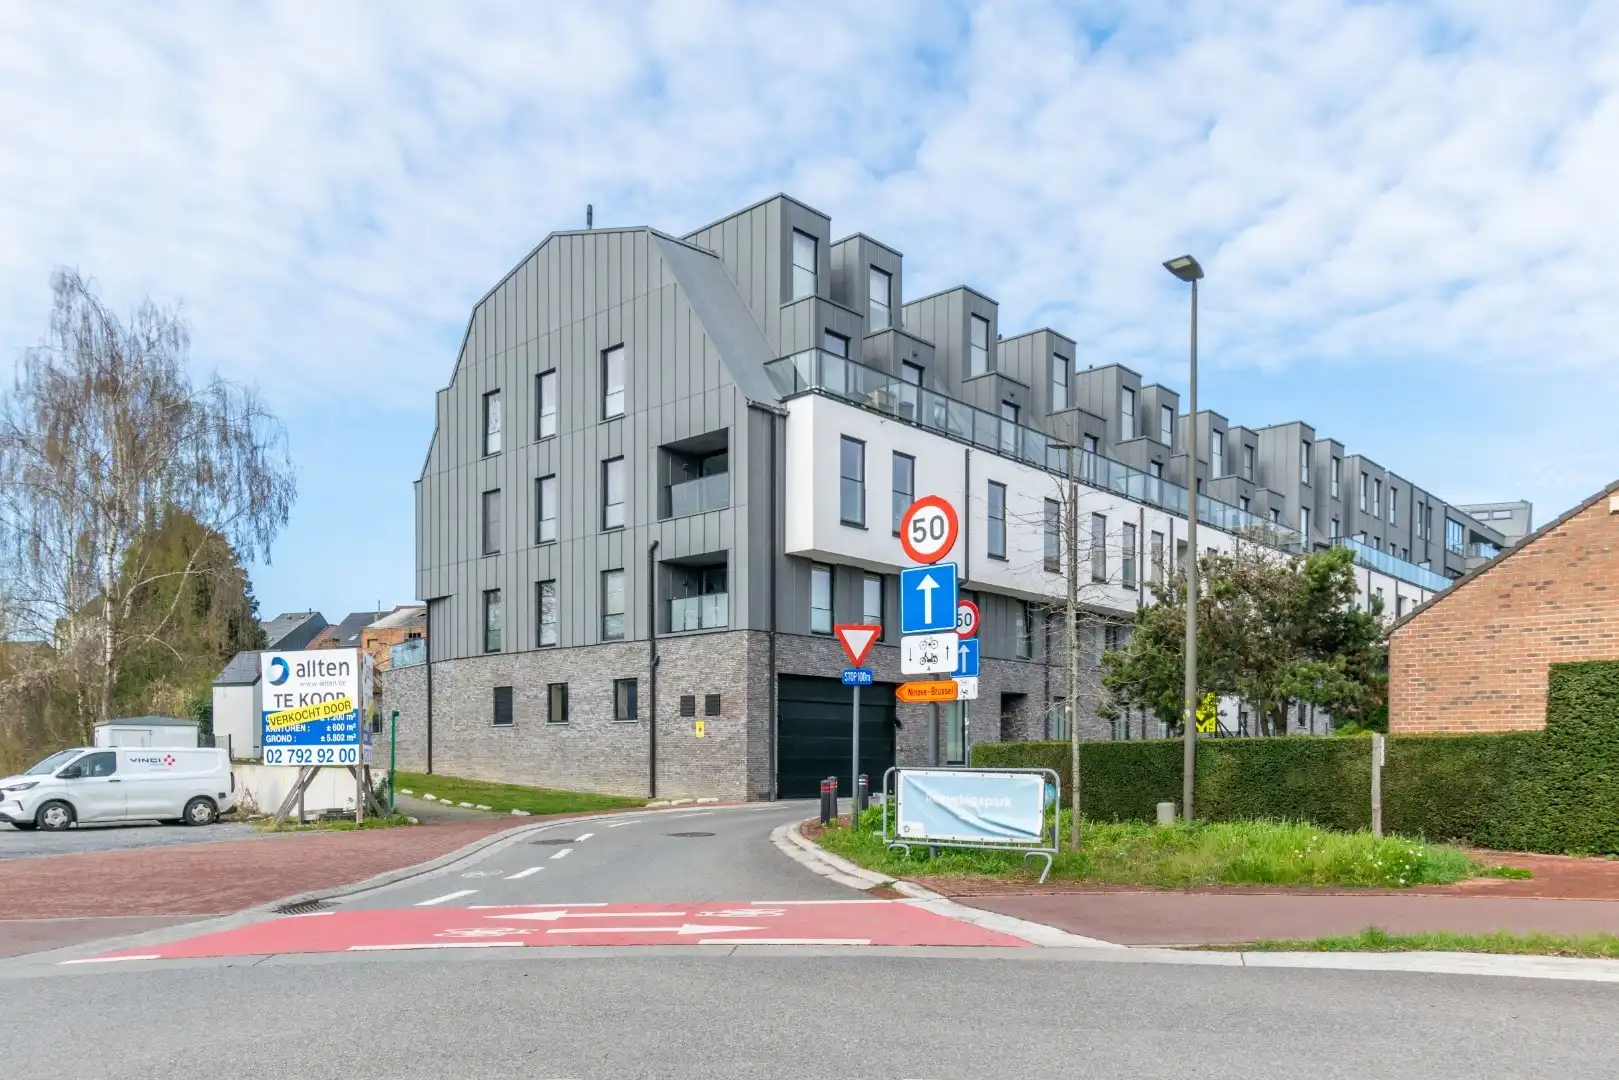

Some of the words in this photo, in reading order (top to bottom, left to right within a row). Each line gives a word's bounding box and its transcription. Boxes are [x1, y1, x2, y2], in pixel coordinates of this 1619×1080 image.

[912, 514, 945, 544] 50
[958, 612, 972, 627] 50
[296, 659, 349, 678] allten
[844, 671, 857, 682] STOP
[858, 671, 871, 682] 100m
[273, 693, 293, 708] TE
[269, 707, 321, 726] VERKOCHT
[323, 700, 352, 715] DOOR
[332, 724, 345, 732] 600
[265, 734, 292, 743] GROND
[266, 749, 282, 764] 02
[287, 748, 312, 763] 792
[317, 748, 334, 763] 92
[339, 748, 356, 763] 00
